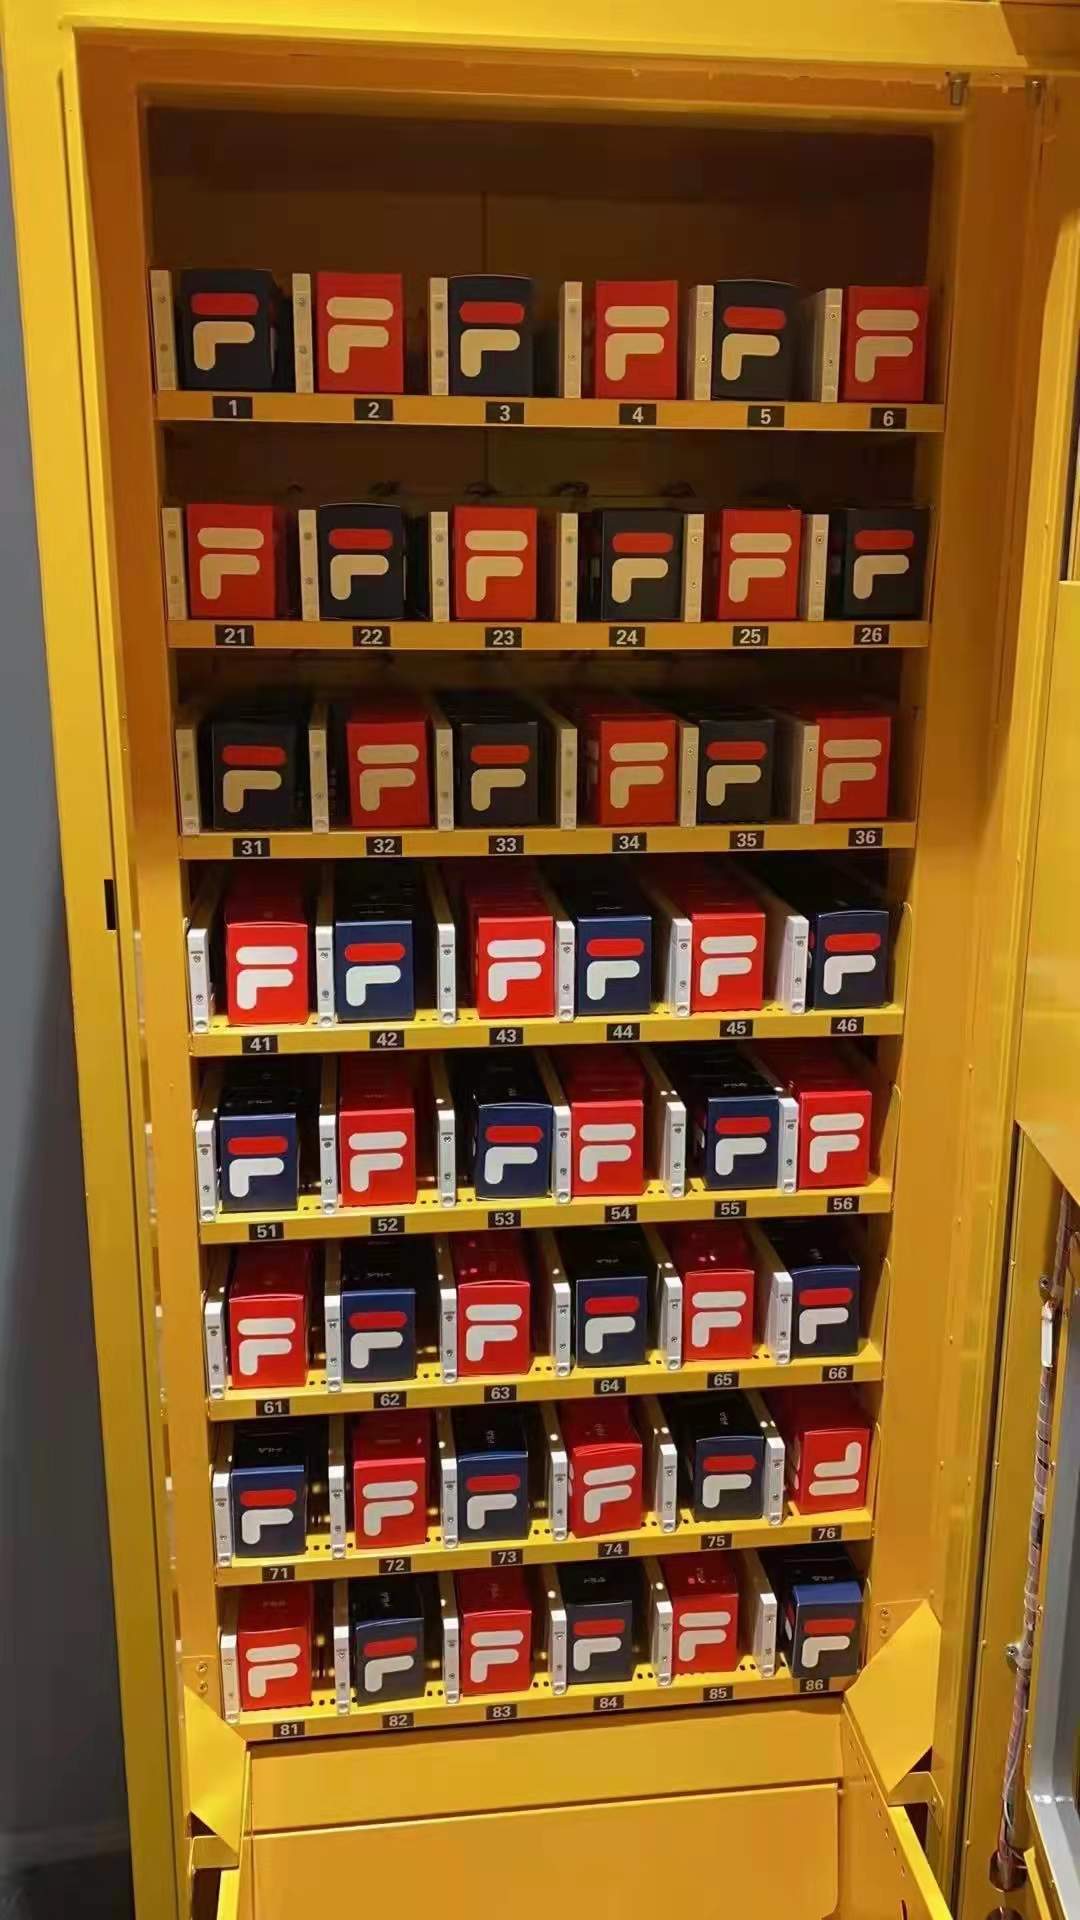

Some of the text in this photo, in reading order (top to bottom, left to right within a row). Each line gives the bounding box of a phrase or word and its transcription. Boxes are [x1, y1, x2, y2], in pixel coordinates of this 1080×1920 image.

[228, 399, 237, 416] 1
[368, 401, 380, 419] 2
[499, 404, 511, 422] 3
[632, 406, 644, 423] 4
[760, 408, 772, 425] 5
[883, 410, 894, 427] 6
[224, 628, 245, 644] 21
[361, 629, 383, 645] 22
[493, 629, 514, 646] 23
[616, 629, 638, 645] 24
[739, 628, 761, 644] 25
[861, 627, 882, 643] 26
[496, 837, 517, 852] 33
[619, 835, 640, 850] 34
[737, 832, 757, 848] 35
[855, 830, 876, 845] 36
[241, 840, 262, 855] 31
[373, 838, 395, 854] 32
[613, 1024, 634, 1039] 44
[726, 1021, 747, 1035] 45
[836, 1018, 858, 1032] 46
[376, 1032, 398, 1047] 42
[495, 1029, 517, 1043] 43
[250, 1036, 271, 1051] 41
[720, 1202, 740, 1216] 55
[833, 1197, 853, 1211] 56
[494, 1212, 515, 1226] 53
[611, 1206, 631, 1220] 54
[257, 1224, 276, 1238] 51
[377, 1218, 398, 1232] 52
[714, 1373, 732, 1386] 65
[828, 1367, 847, 1380] 66
[600, 1379, 620, 1392] 64
[380, 1393, 400, 1407] 62
[490, 1386, 510, 1400] 63
[264, 1401, 282, 1414] 61
[818, 1527, 836, 1540] 76
[708, 1535, 727, 1548] 75
[604, 1543, 623, 1556] 74
[497, 1551, 517, 1564] 73
[386, 1559, 405, 1572] 72
[269, 1567, 288, 1580] 71
[806, 1679, 824, 1691] 86
[709, 1688, 727, 1700] 85
[599, 1696, 617, 1709] 84
[492, 1705, 511, 1718] 83
[389, 1714, 408, 1727] 82
[280, 1723, 298, 1736] 81
